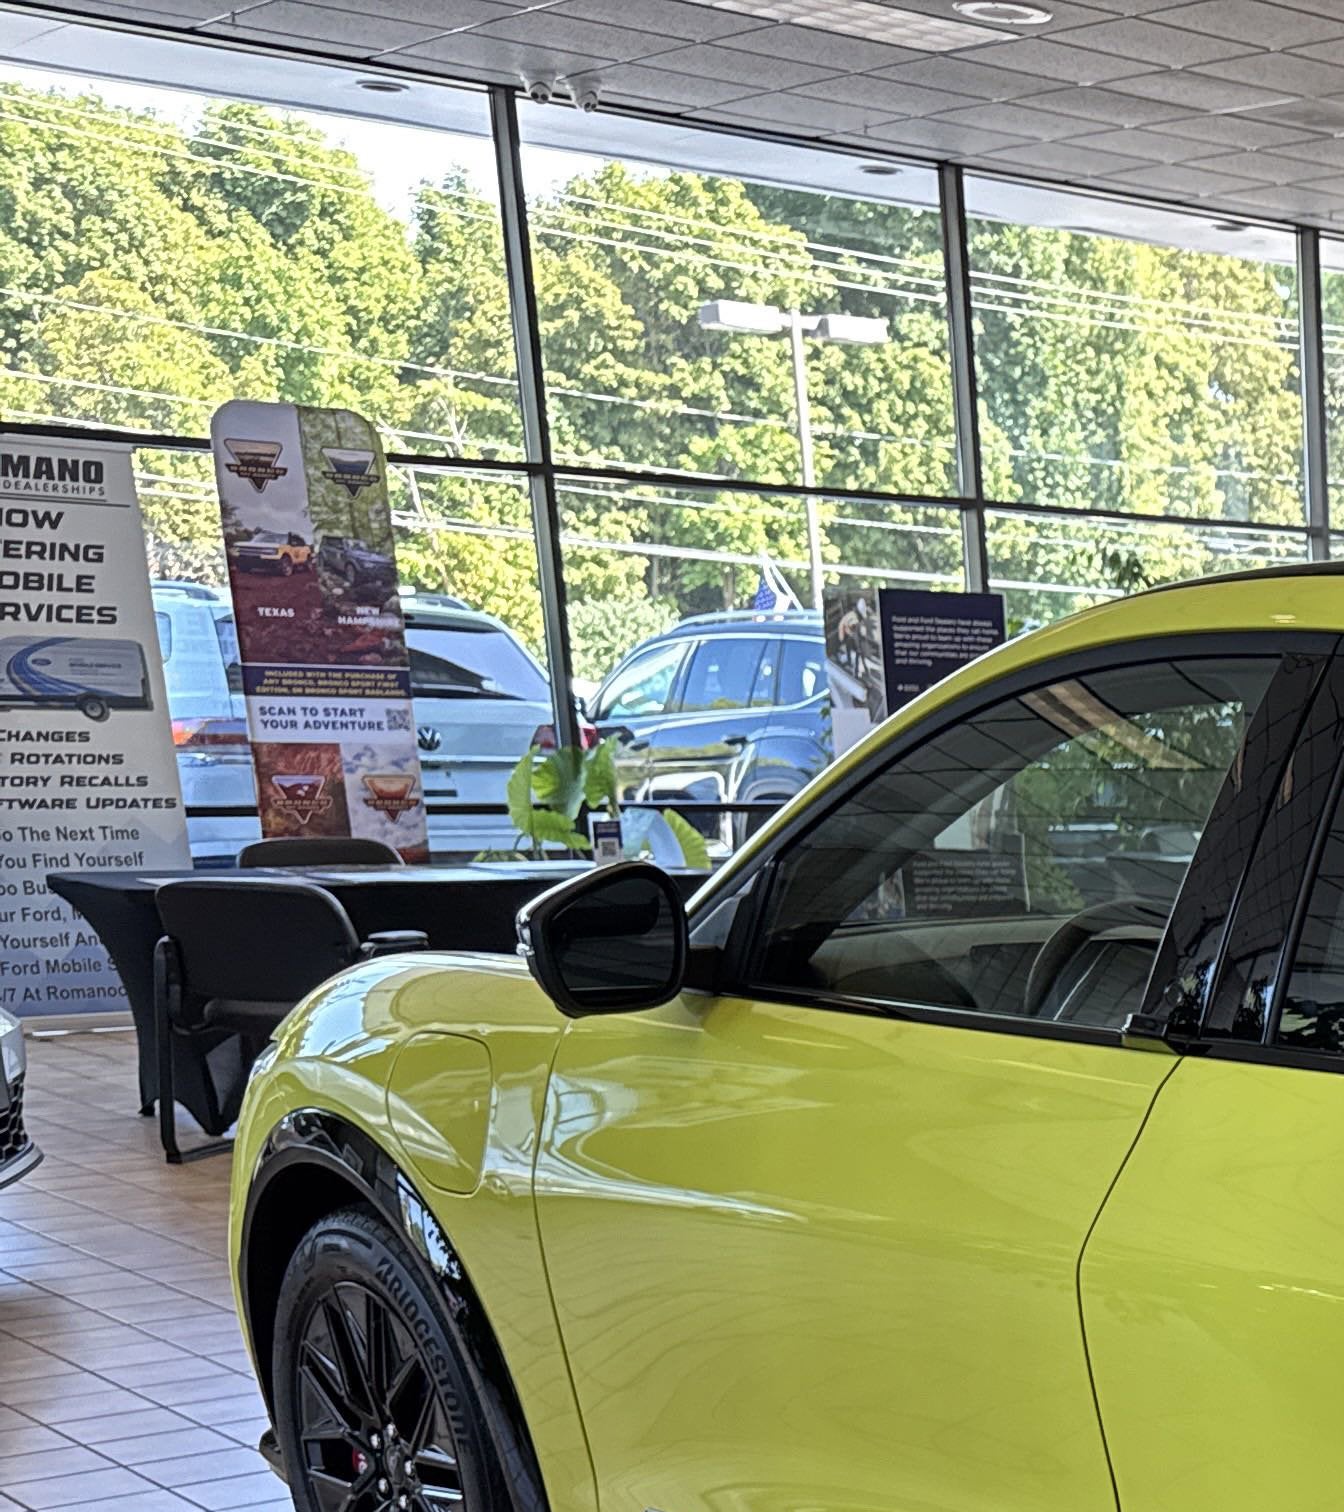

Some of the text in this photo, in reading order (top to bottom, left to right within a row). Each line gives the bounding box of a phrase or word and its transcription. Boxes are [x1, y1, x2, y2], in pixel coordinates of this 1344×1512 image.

[0, 454, 104, 484] MANO
[3, 480, 105, 497] DEALERSHIPS
[0, 507, 64, 530] OW
[0, 540, 105, 563] ERING
[257, 606, 295, 618] TEXAS
[259, 706, 366, 719] SCAN TO START
[260, 719, 385, 731] YOUR ADVENTURE
[10, 752, 124, 766] ROTATIONS
[60, 775, 148, 788] RECALLS
[86, 796, 177, 809] UPDATES
[0, 826, 140, 843] o The Next Time
[32, 853, 70, 868] Find
[74, 851, 145, 868] Yourself
[22, 907, 67, 924] Ford,
[0, 932, 102, 950] Yourself An
[1, 960, 40, 976] Ford
[46, 957, 102, 974] Mobile
[0, 987, 17, 1001] /7
[23, 987, 42, 1001] At
